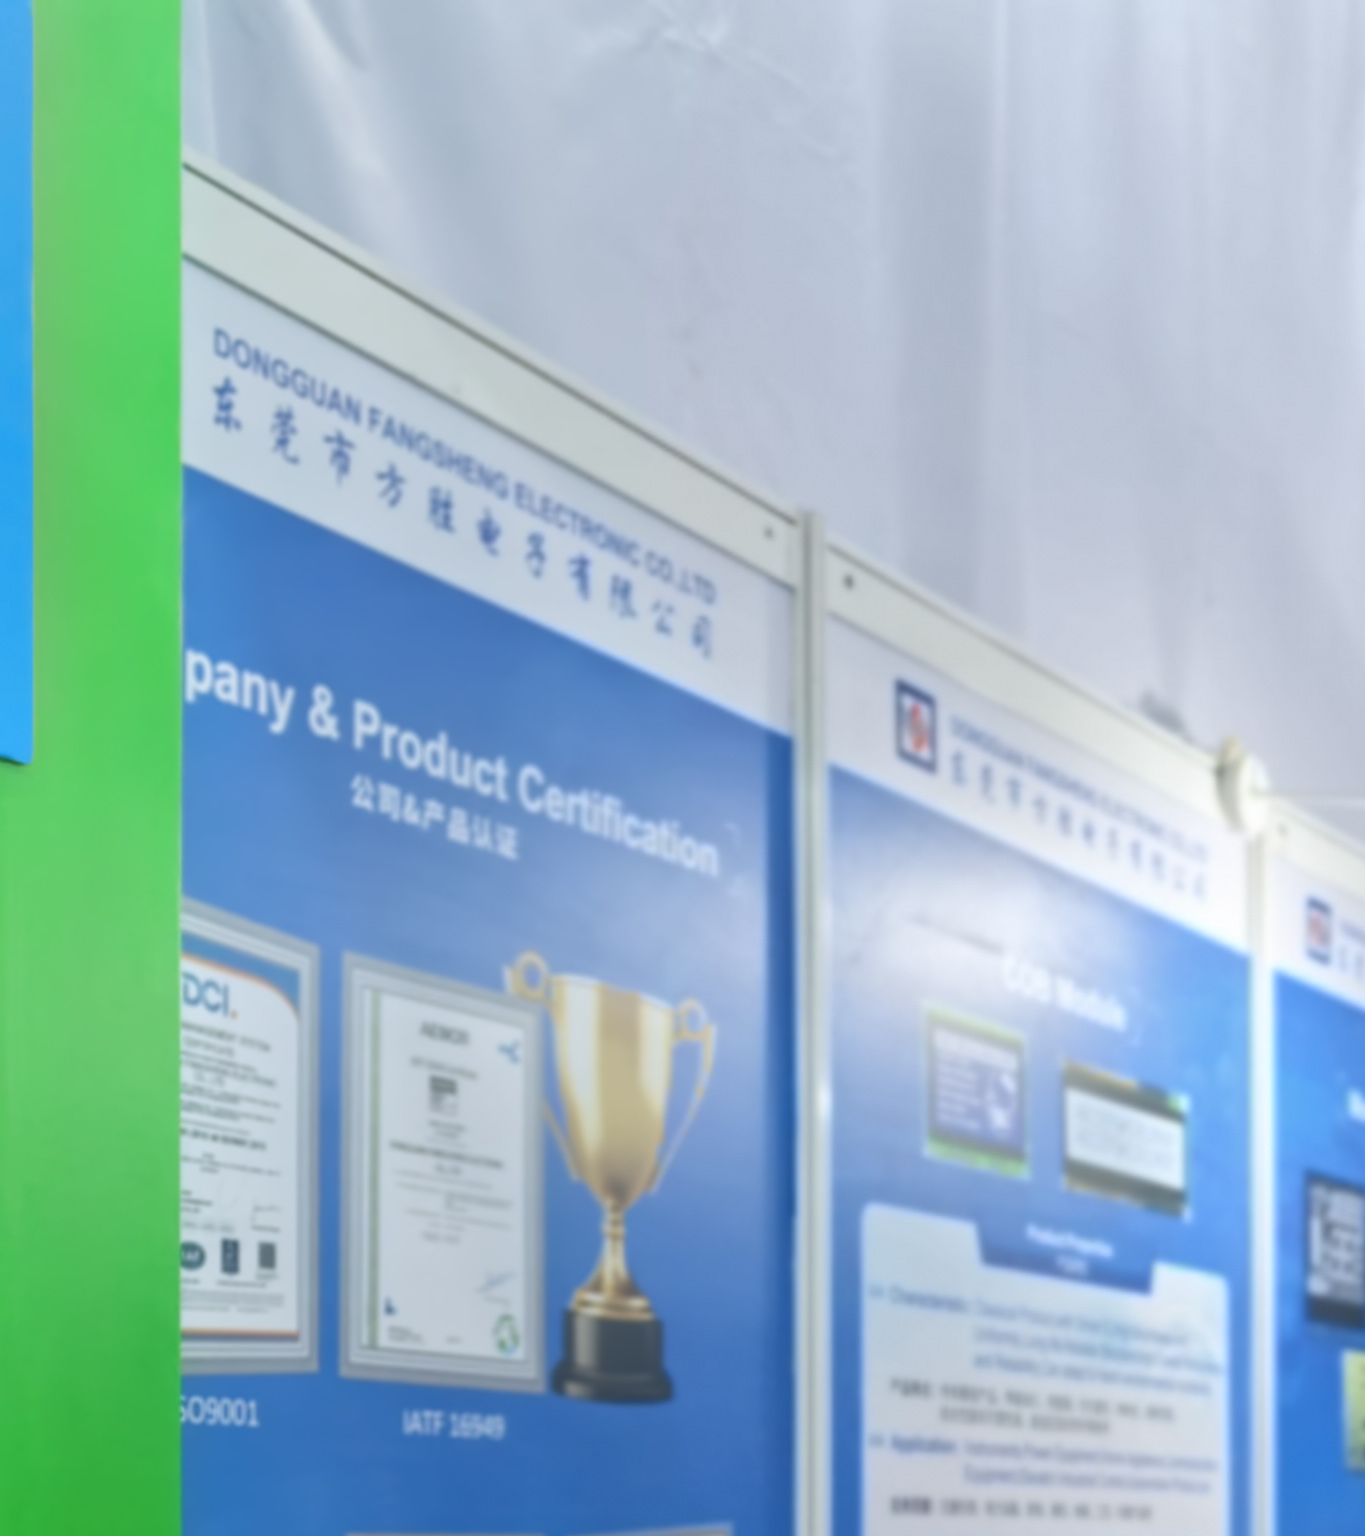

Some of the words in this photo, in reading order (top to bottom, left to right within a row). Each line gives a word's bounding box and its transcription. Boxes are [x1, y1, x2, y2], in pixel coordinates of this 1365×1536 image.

[214, 328, 362, 426] DONGGUAN
[367, 405, 510, 502] FANGSHENG
[513, 480, 641, 572] ELECTRONIC
[307, 685, 341, 741] &
[352, 699, 509, 802] Product
[517, 764, 721, 877] Certification
[402, 1409, 446, 1437] IATF
